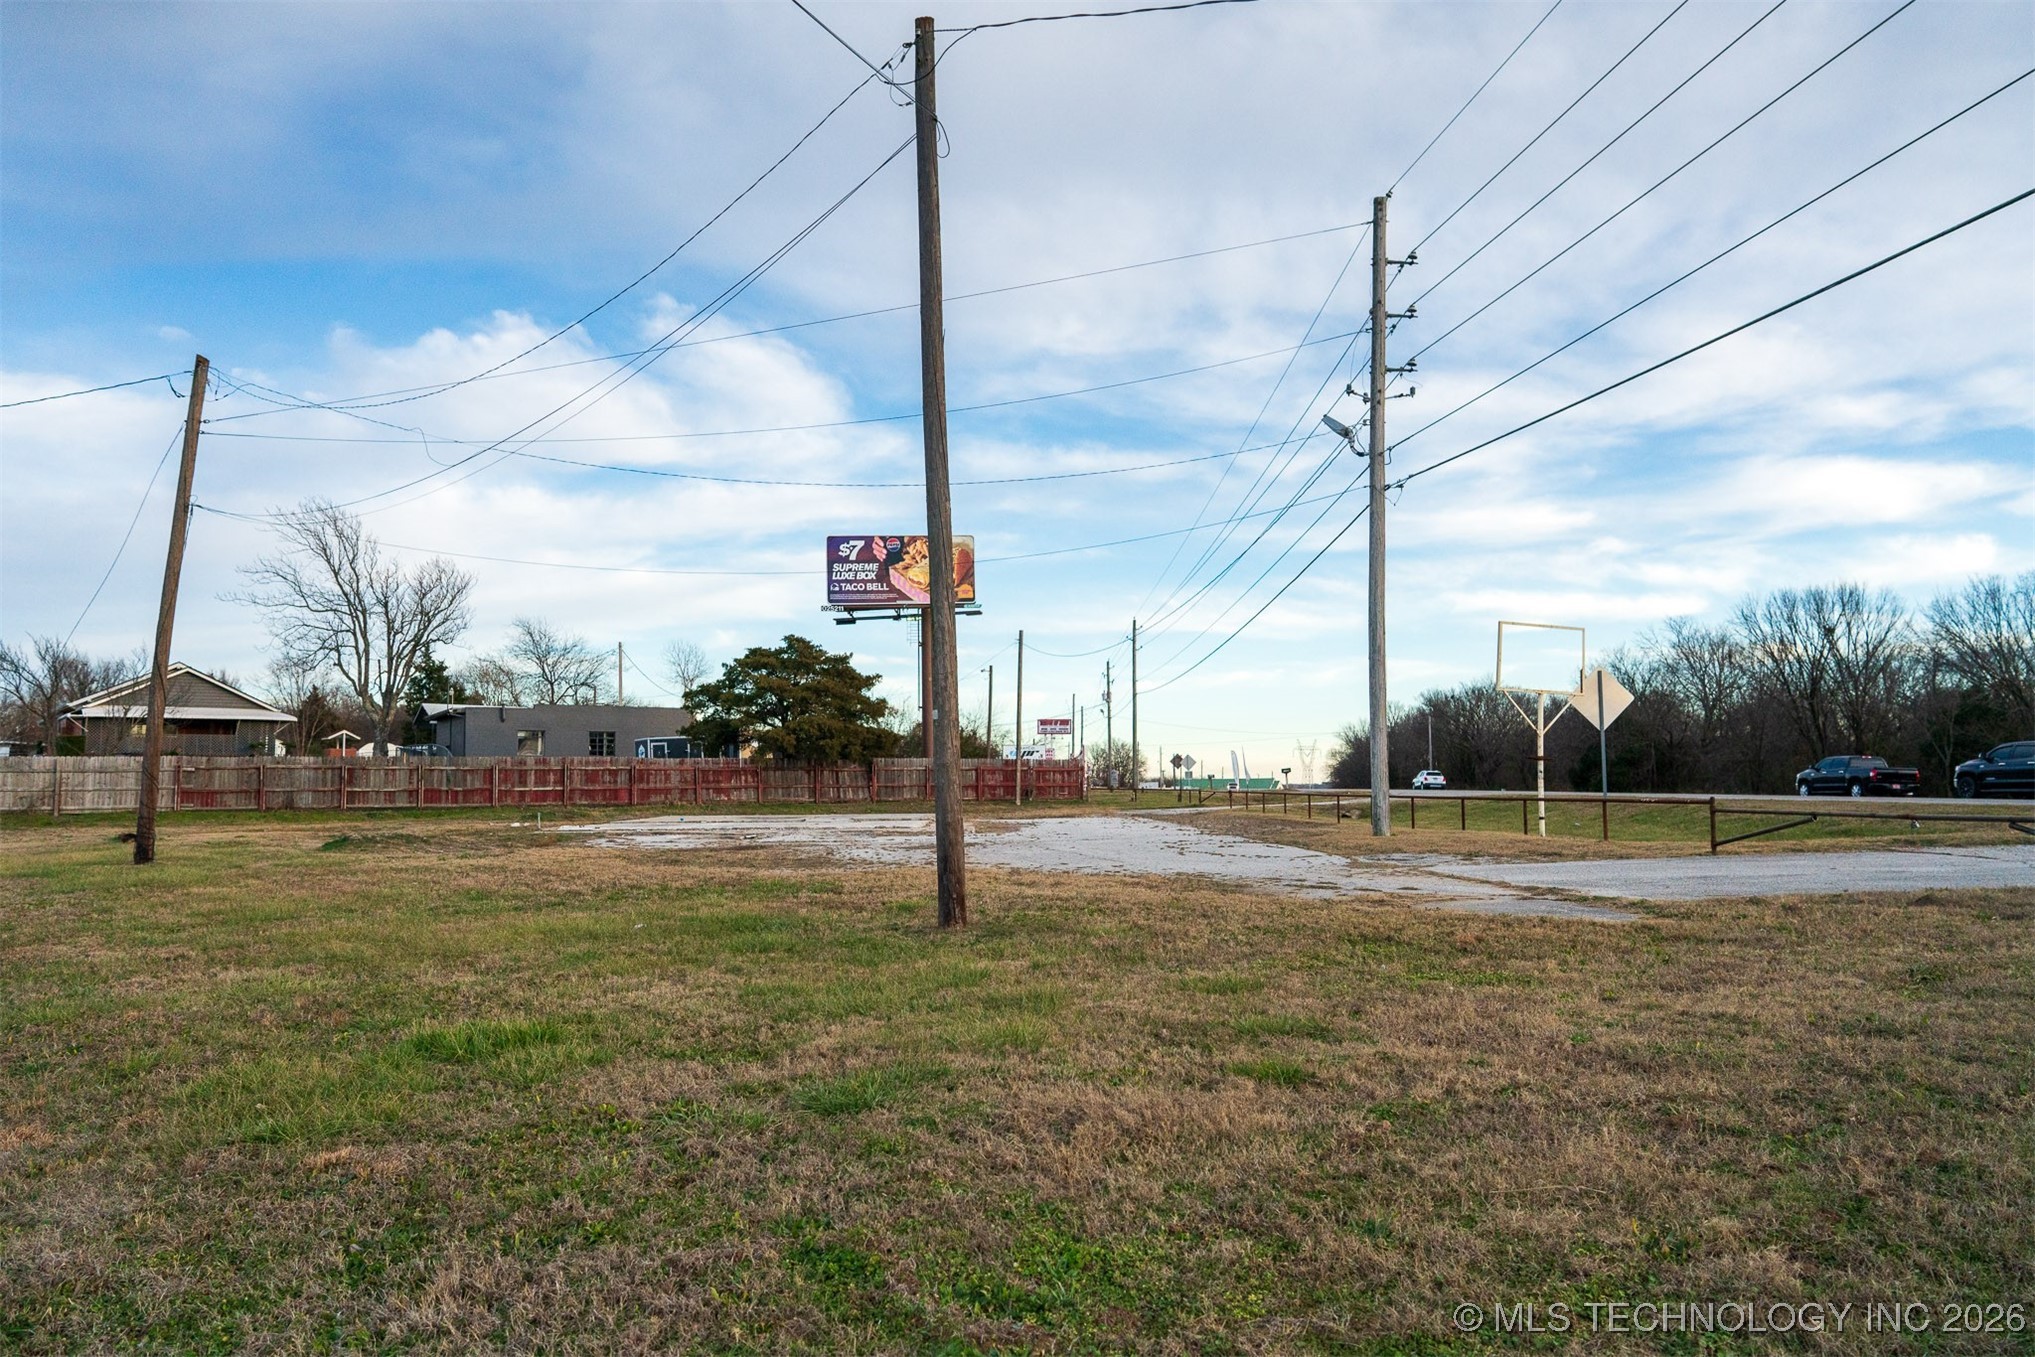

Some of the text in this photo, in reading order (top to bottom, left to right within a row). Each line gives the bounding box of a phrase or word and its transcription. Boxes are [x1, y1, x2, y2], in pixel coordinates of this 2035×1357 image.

[838, 540, 865, 561] $7
[832, 563, 879, 571] SUPREME
[832, 571, 877, 580] LUXE BOX
[840, 583, 889, 591] TACO BELL
